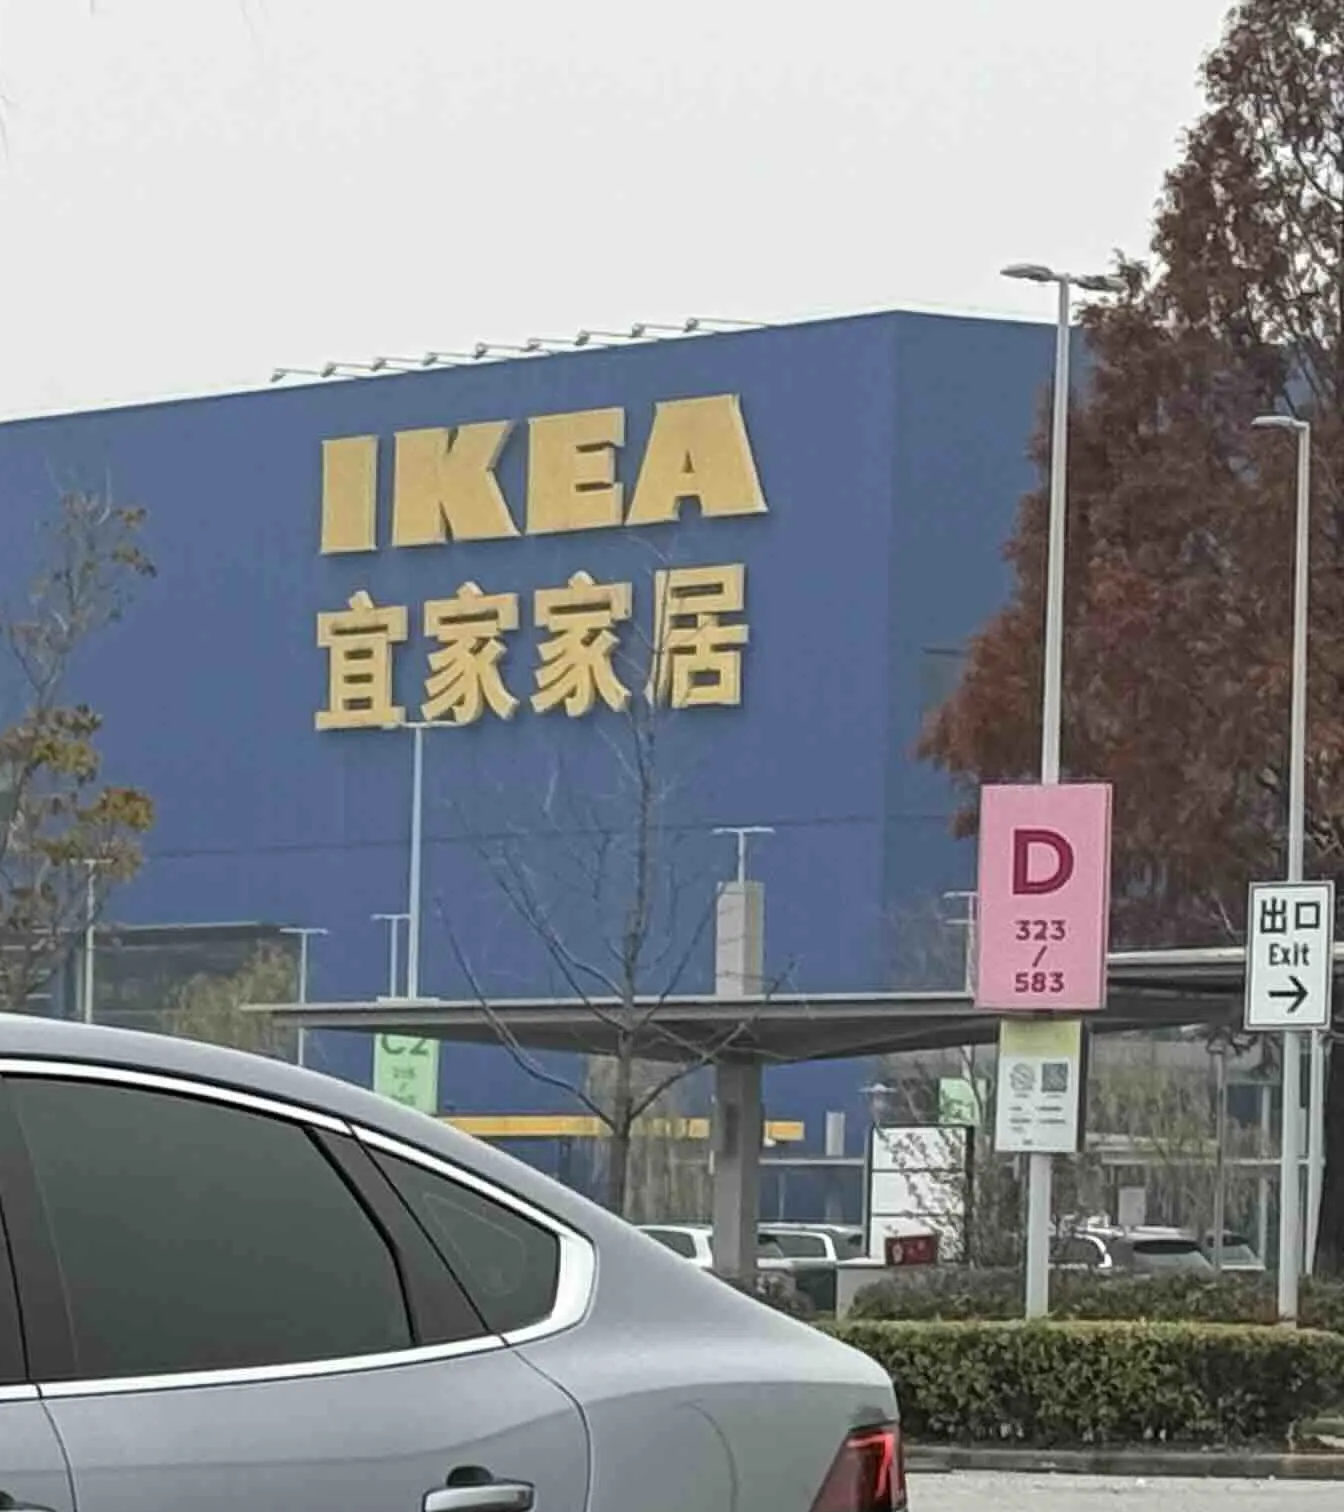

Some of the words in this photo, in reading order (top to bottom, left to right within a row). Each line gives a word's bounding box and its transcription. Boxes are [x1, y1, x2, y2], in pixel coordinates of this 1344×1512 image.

[319, 394, 769, 555] IKEA
[315, 563, 750, 731] 宜家家居
[1013, 829, 1074, 895] D
[1015, 919, 1066, 941] 323
[1260, 896, 1320, 935] 出口
[1269, 942, 1309, 967] Exit
[1014, 971, 1065, 994] 583
